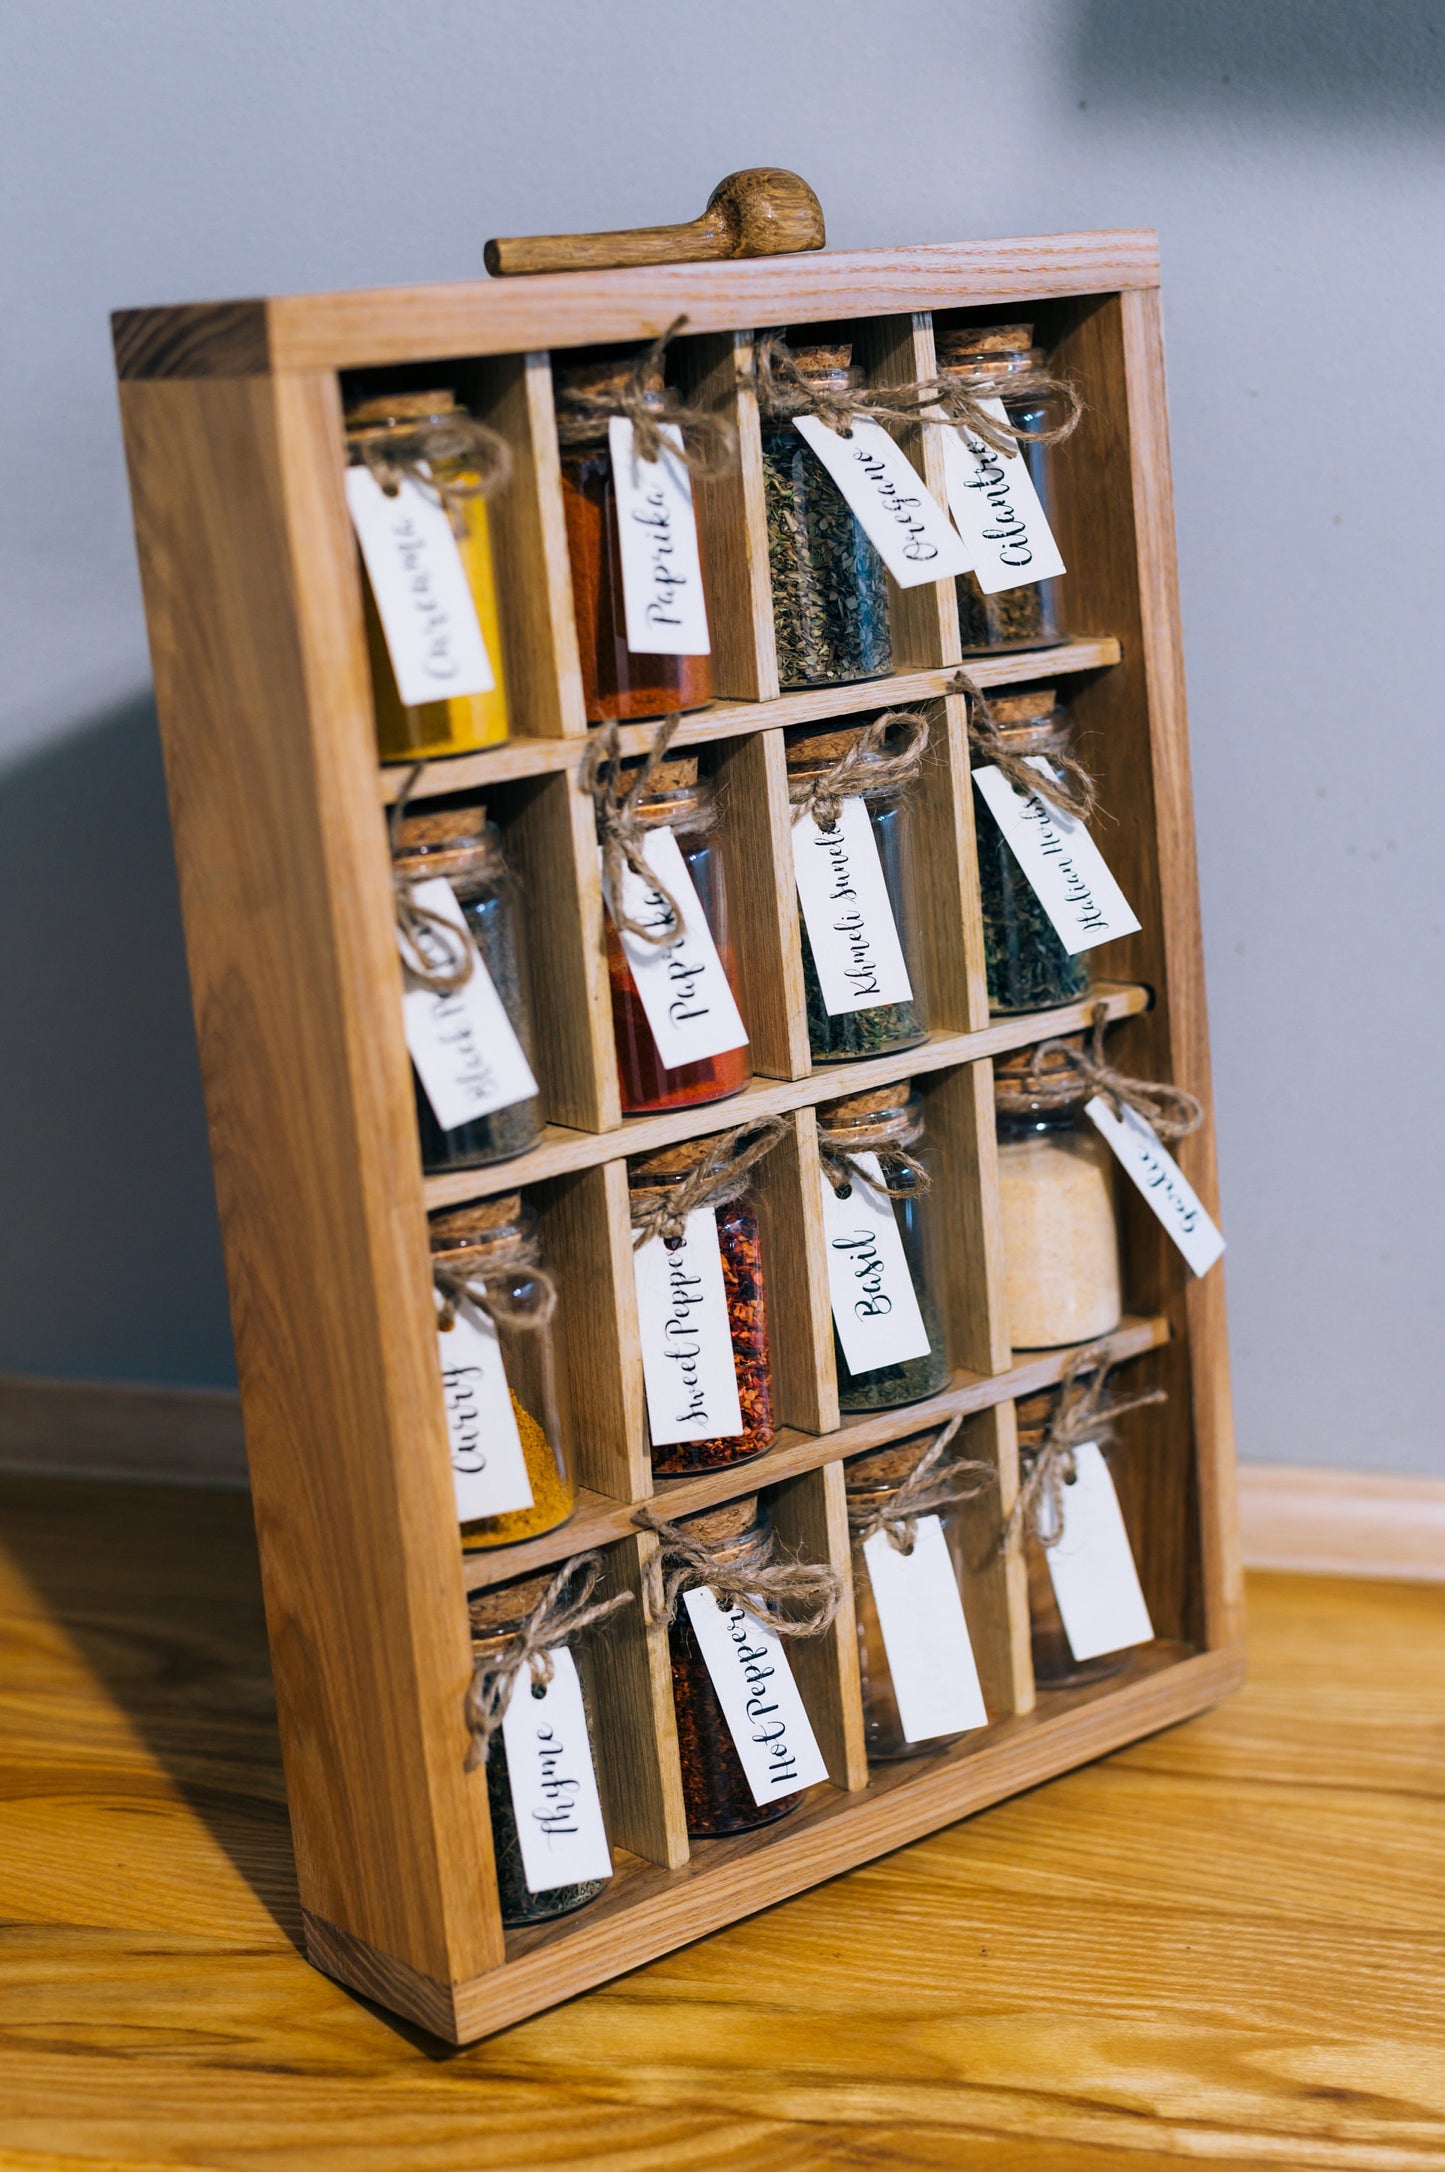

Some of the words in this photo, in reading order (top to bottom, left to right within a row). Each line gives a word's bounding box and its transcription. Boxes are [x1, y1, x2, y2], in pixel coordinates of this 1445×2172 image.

[633, 485, 687, 631] Paprika
[852, 447, 938, 560] Oregano
[963, 441, 1032, 566] Cilantro
[1058, 857, 1109, 934] Italian
[640, 891, 709, 1030] Paprka
[834, 908, 880, 997] Khmeli
[831, 1229, 893, 1322] Basil
[441, 1364, 486, 1474] Curry
[663, 1340, 709, 1430] Sweet
[726, 1608, 779, 1724] Pepper
[532, 1722, 580, 1850] Thyme
[752, 1721, 798, 1784] Hot
